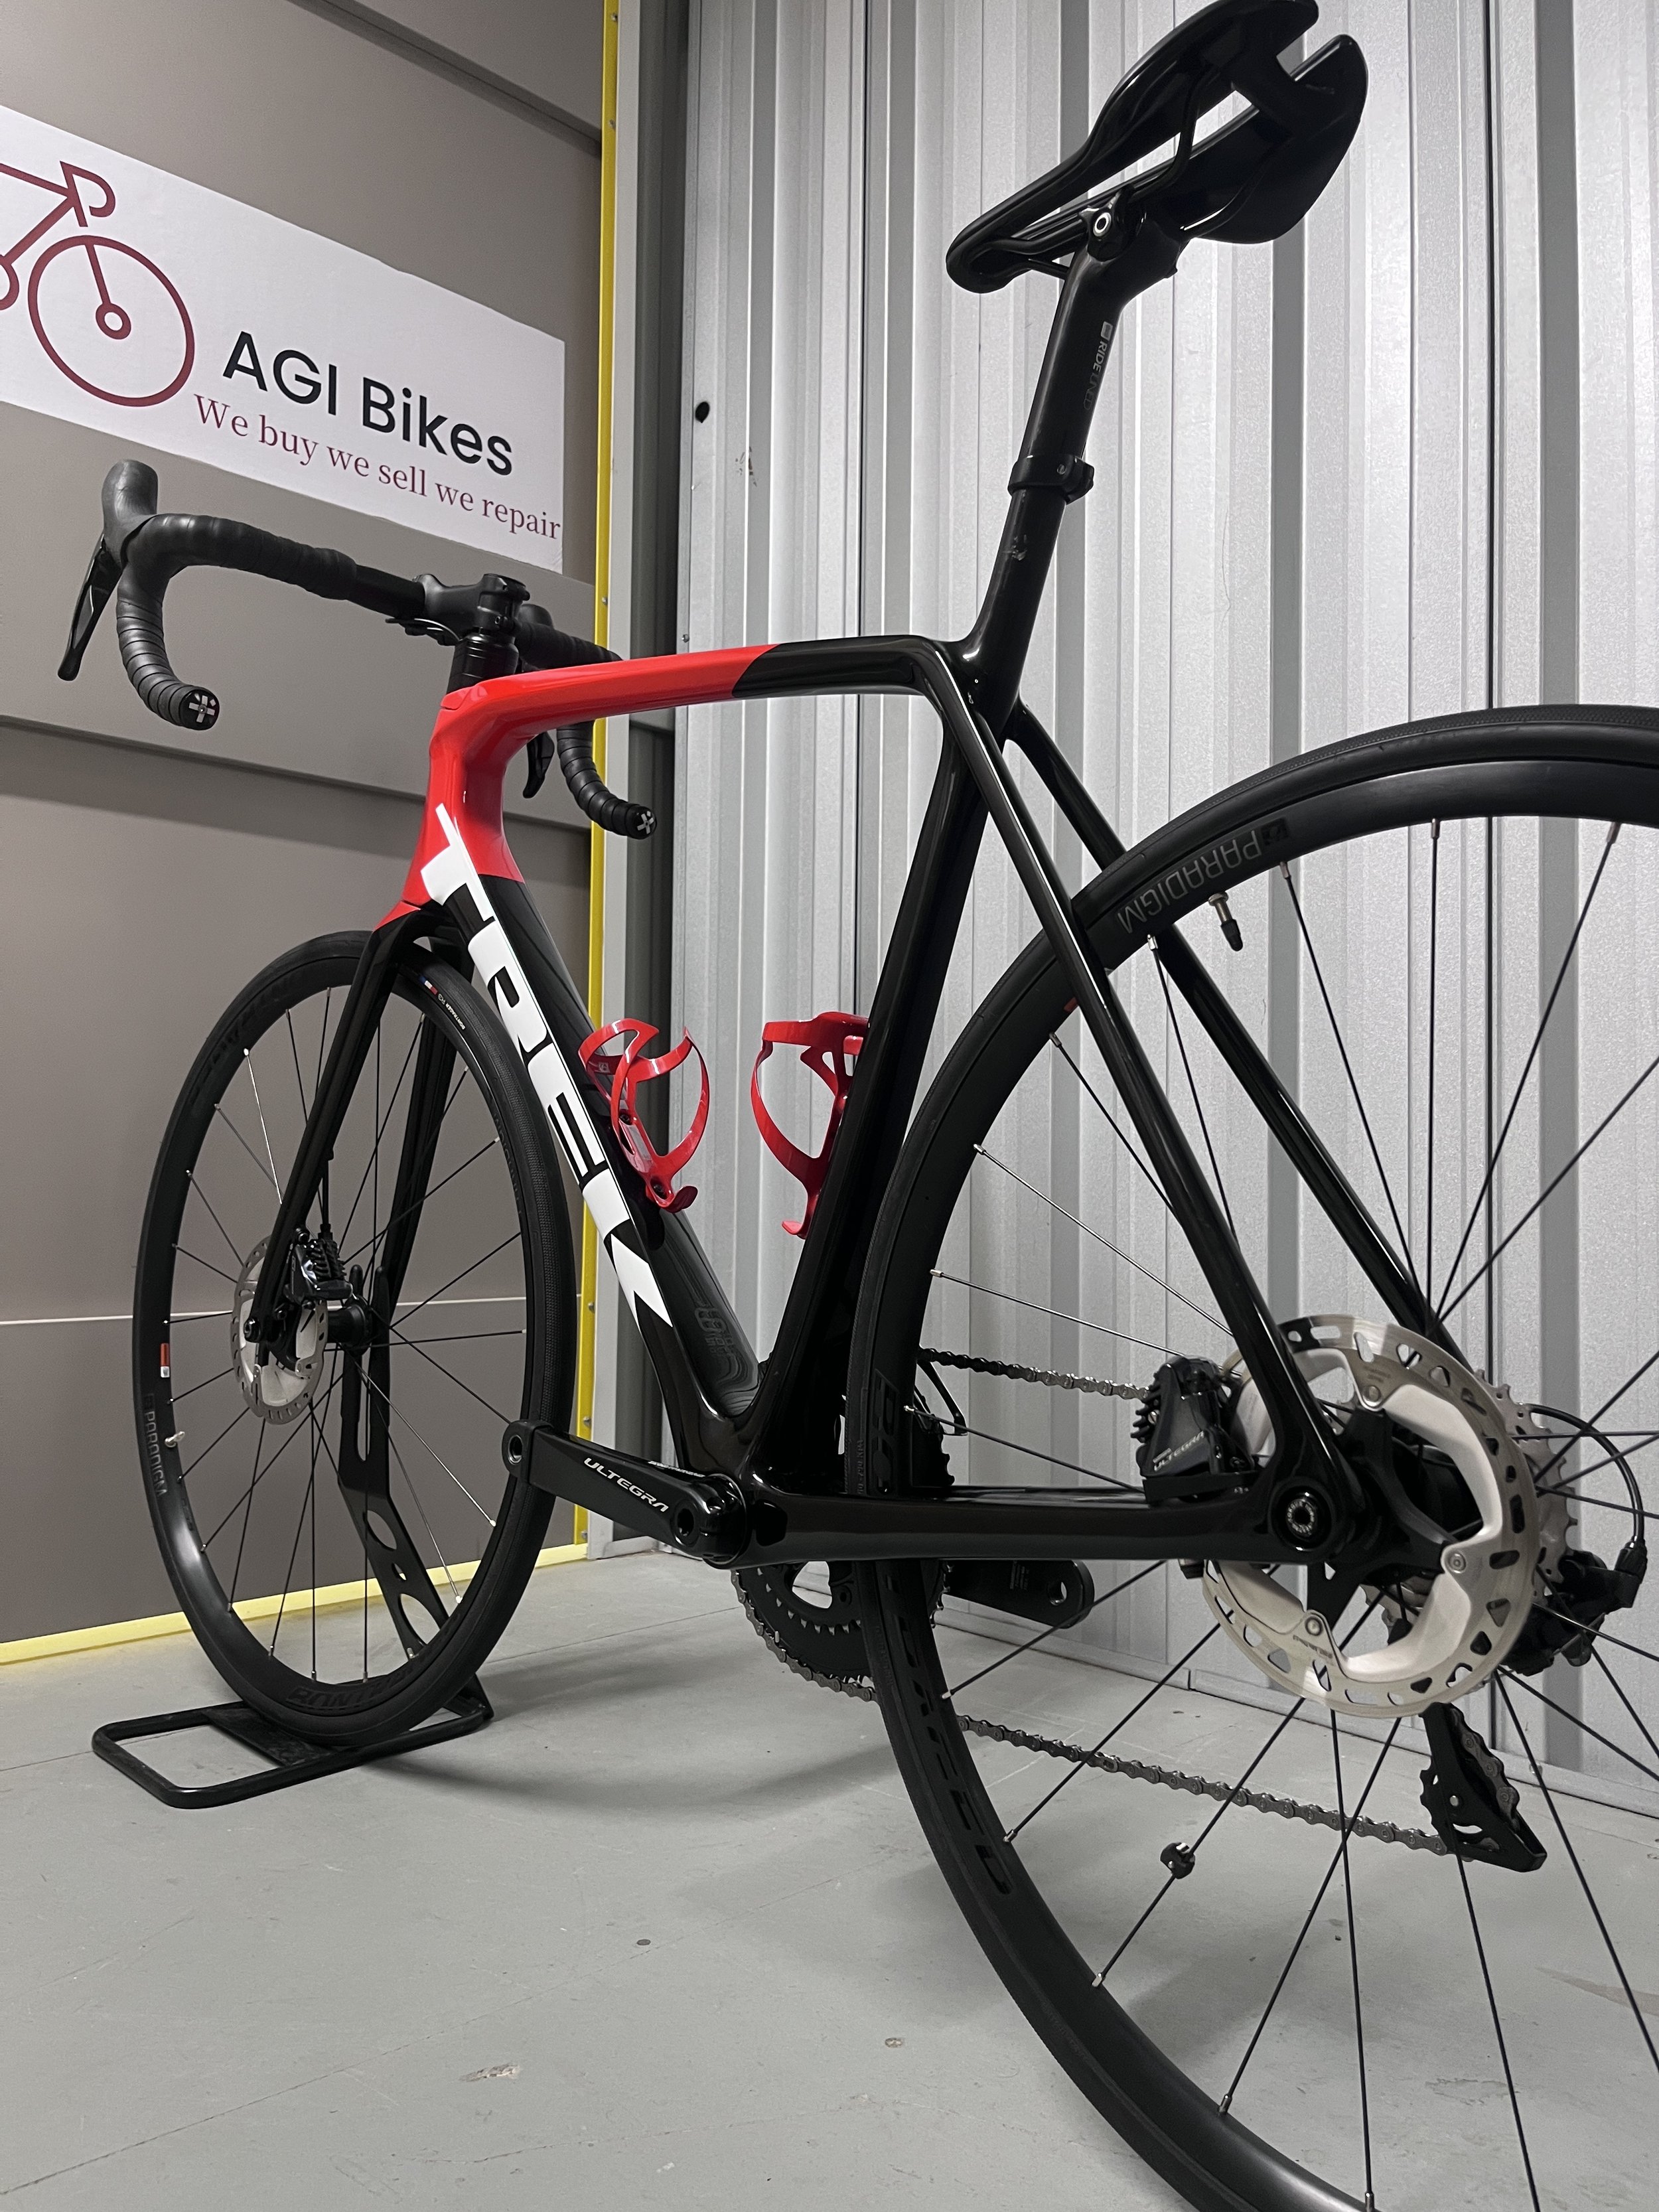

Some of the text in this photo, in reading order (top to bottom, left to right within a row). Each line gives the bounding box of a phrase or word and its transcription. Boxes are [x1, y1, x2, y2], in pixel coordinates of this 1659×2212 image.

[222, 331, 512, 476] AGI Bikes
[1092, 340, 1108, 372] RIDE
[193, 393, 563, 541] We buy we sell we repair
[1118, 830, 1262, 934] PARADIGM
[420, 802, 673, 1333] TREK
[145, 1410, 168, 1497] PARADIGM
[583, 1457, 669, 1512] ULTEGRA
